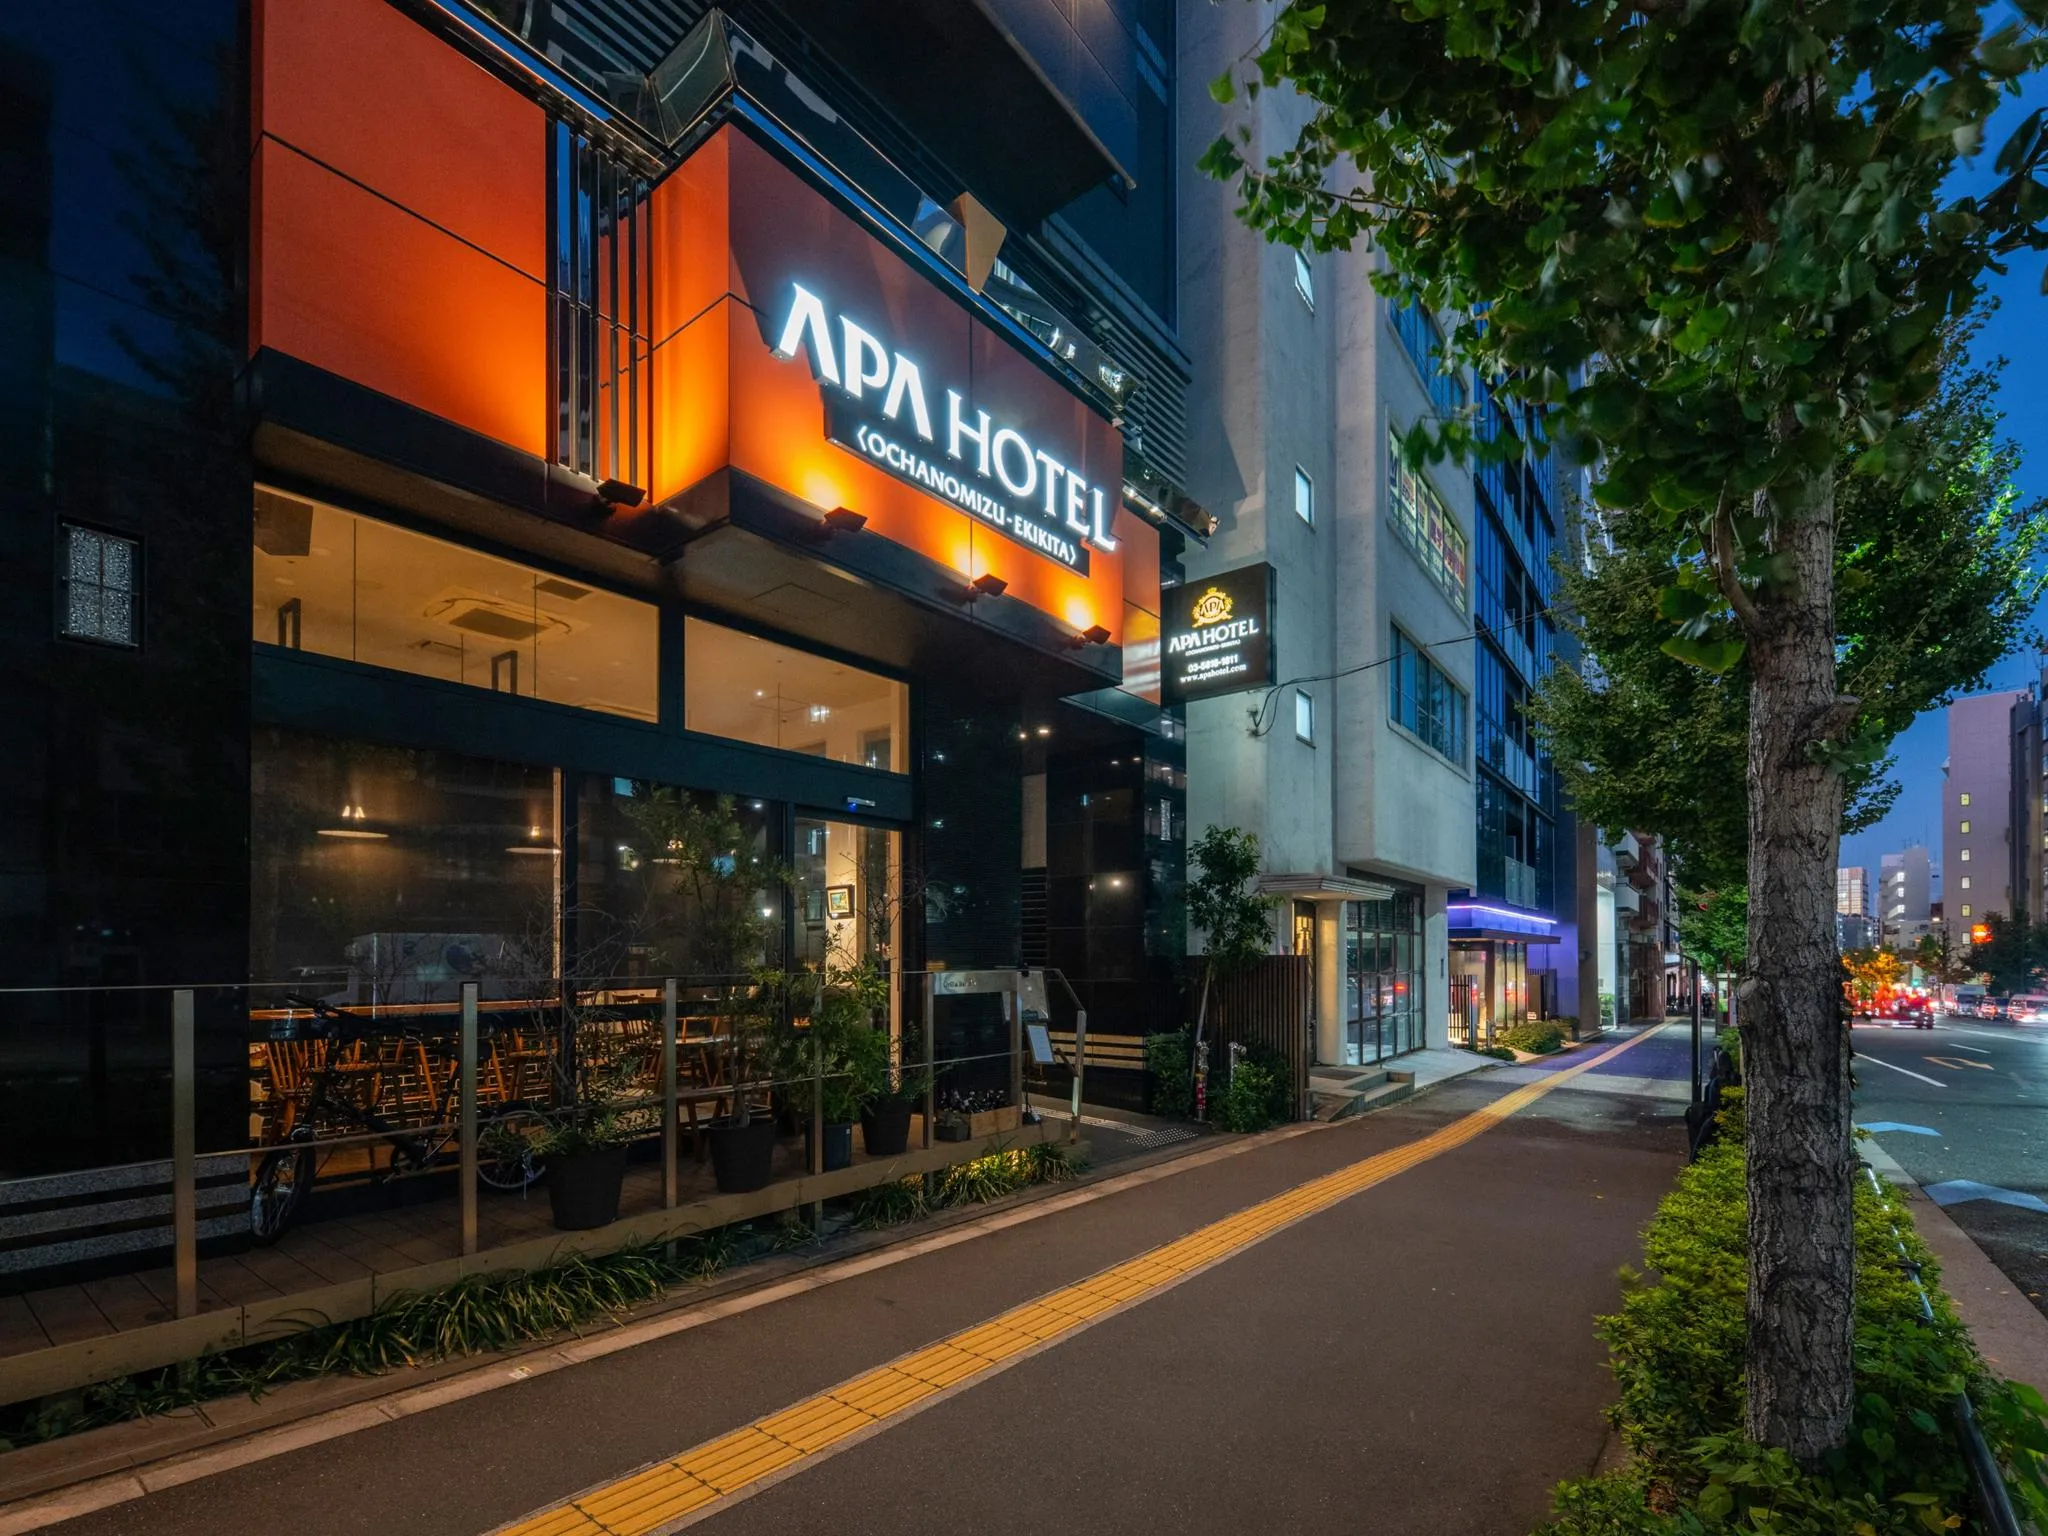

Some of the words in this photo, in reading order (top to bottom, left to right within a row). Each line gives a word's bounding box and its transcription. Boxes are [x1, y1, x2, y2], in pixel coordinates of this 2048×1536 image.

[777, 281, 934, 441] APA
[946, 388, 1117, 551] HOTEL
[1169, 632, 1201, 654] APA
[1202, 619, 1259, 645] HOTEL
[1180, 664, 1246, 683] www.apahotel.com
